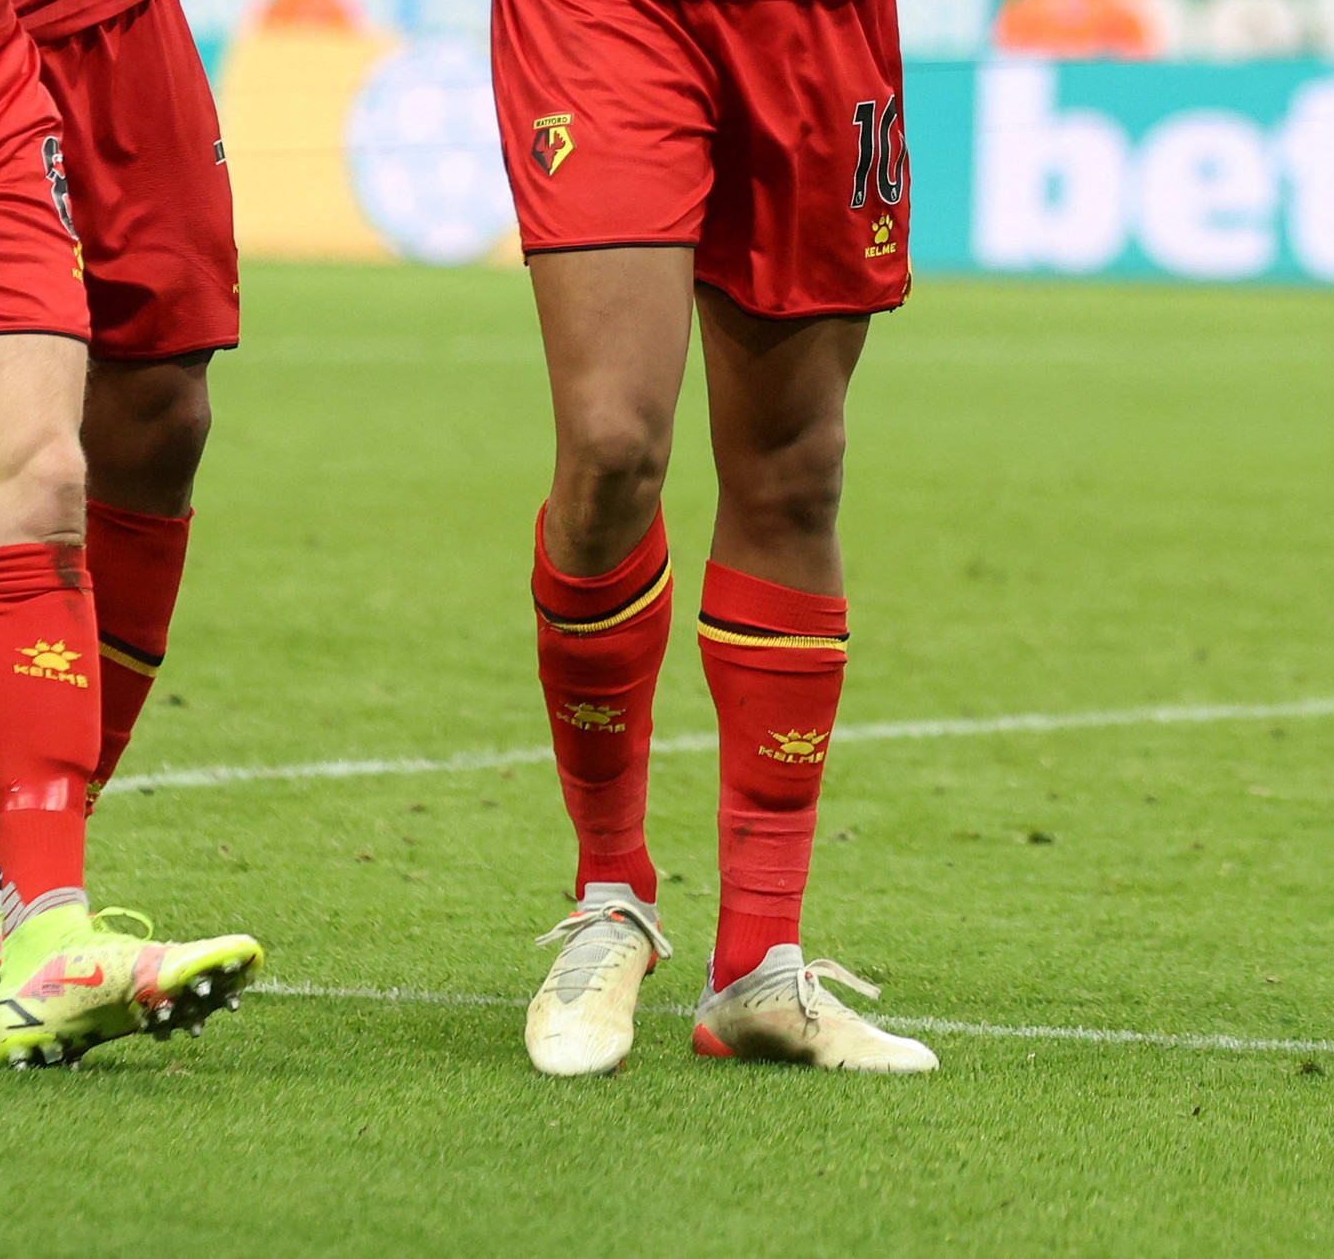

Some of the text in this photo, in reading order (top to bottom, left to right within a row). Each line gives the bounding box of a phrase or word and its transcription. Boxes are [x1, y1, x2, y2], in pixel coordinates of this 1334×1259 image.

[536, 116, 568, 128] WATFORD
[850, 94, 908, 209] 10
[864, 242, 897, 259] KELME
